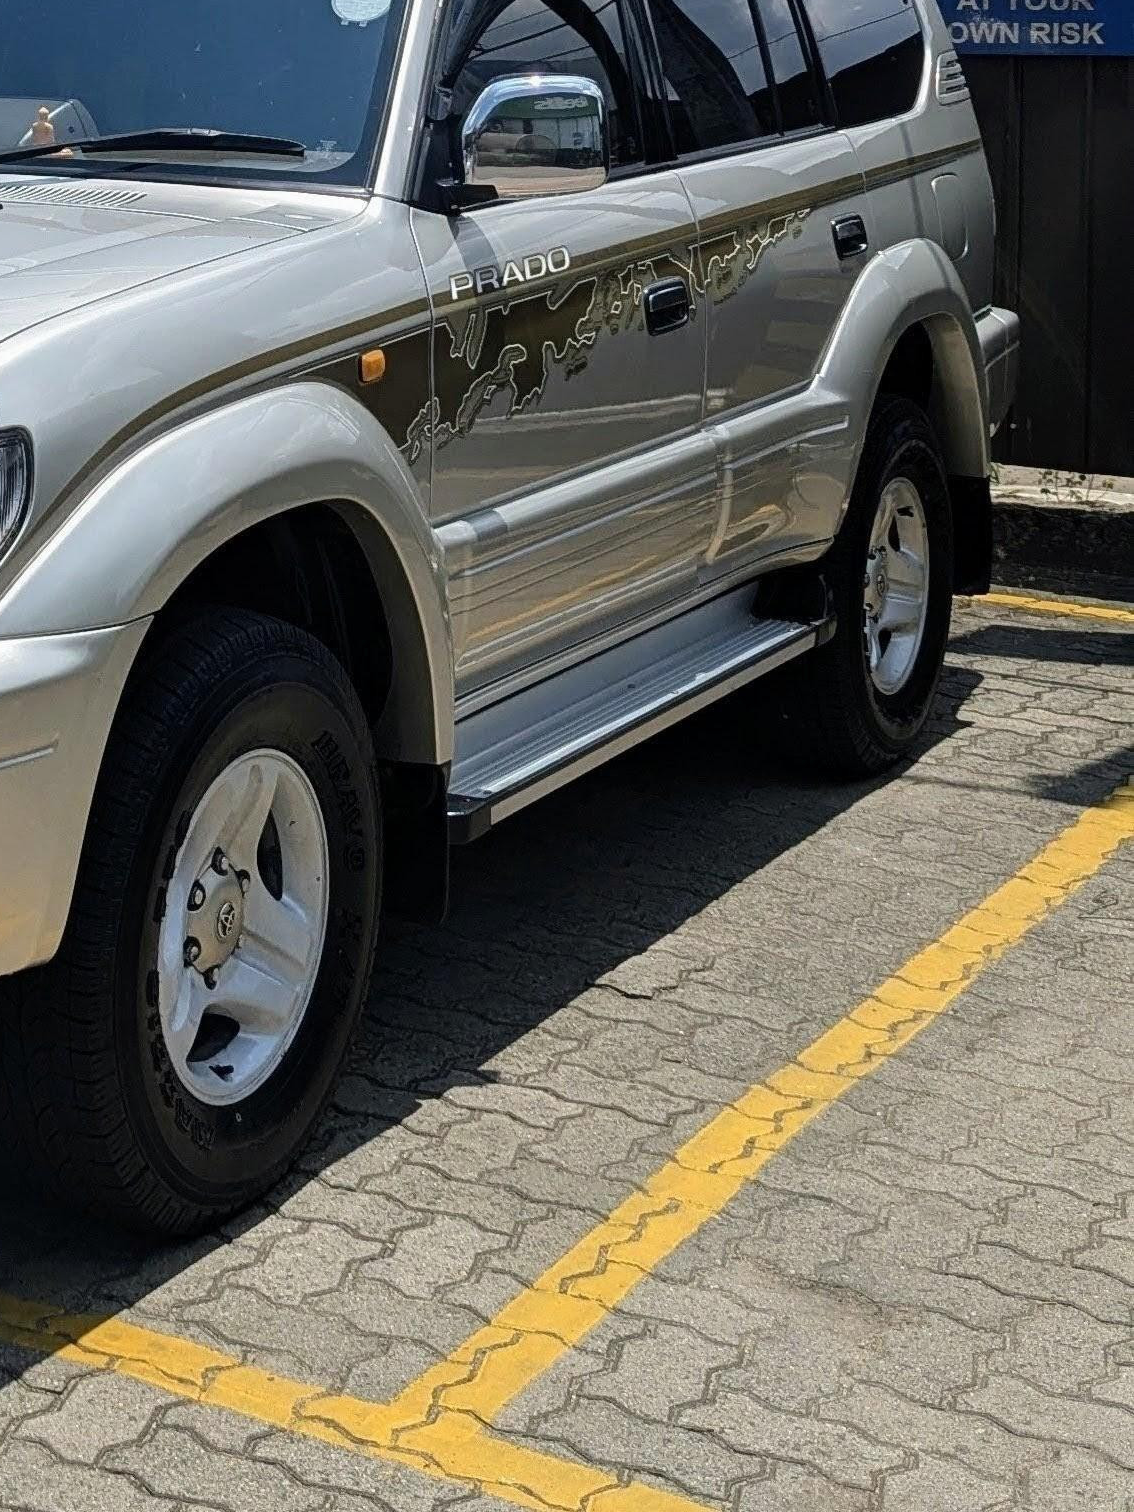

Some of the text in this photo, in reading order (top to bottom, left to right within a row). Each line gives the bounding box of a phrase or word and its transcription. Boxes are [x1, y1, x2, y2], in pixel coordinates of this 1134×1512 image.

[948, 21, 1106, 45] OWN RISK
[449, 245, 571, 301] PRADO
